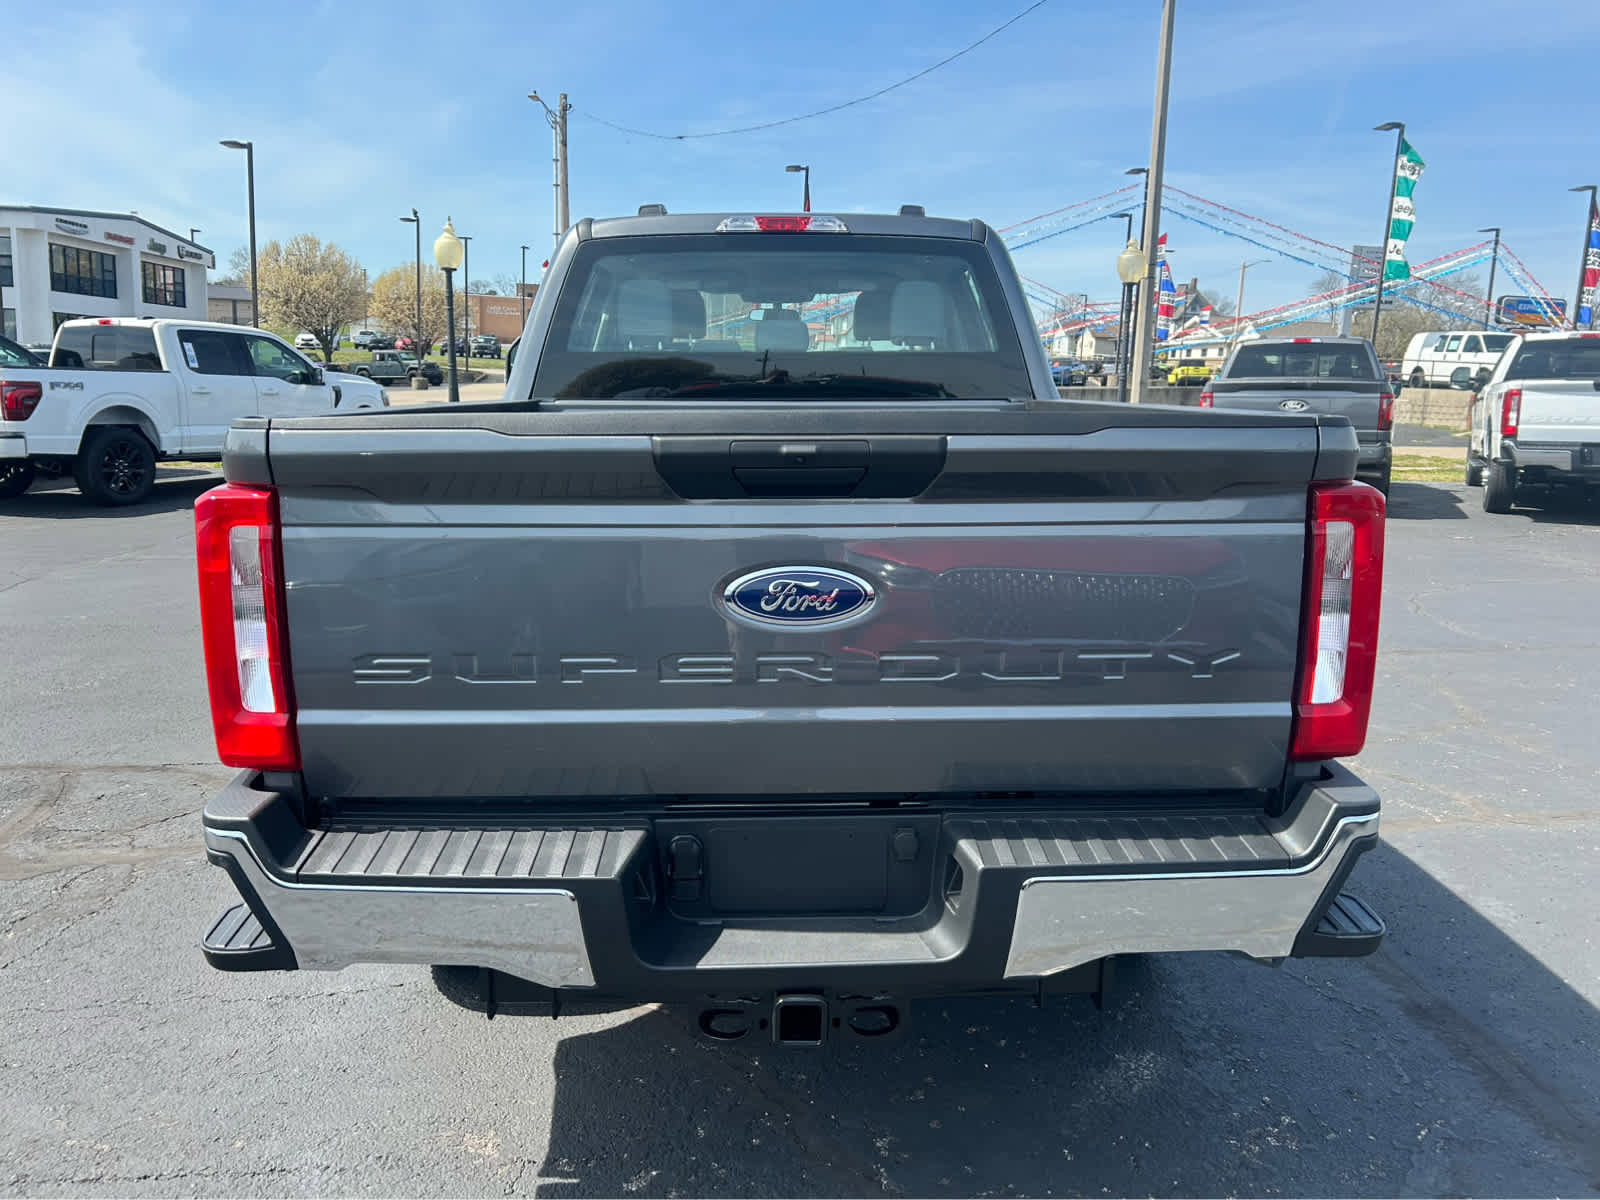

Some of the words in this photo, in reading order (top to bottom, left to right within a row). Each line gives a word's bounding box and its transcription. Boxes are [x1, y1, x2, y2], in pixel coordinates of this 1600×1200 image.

[760, 579, 840, 612] Ford
[353, 652, 834, 684] SUPER
[879, 649, 1241, 682] DUTY
